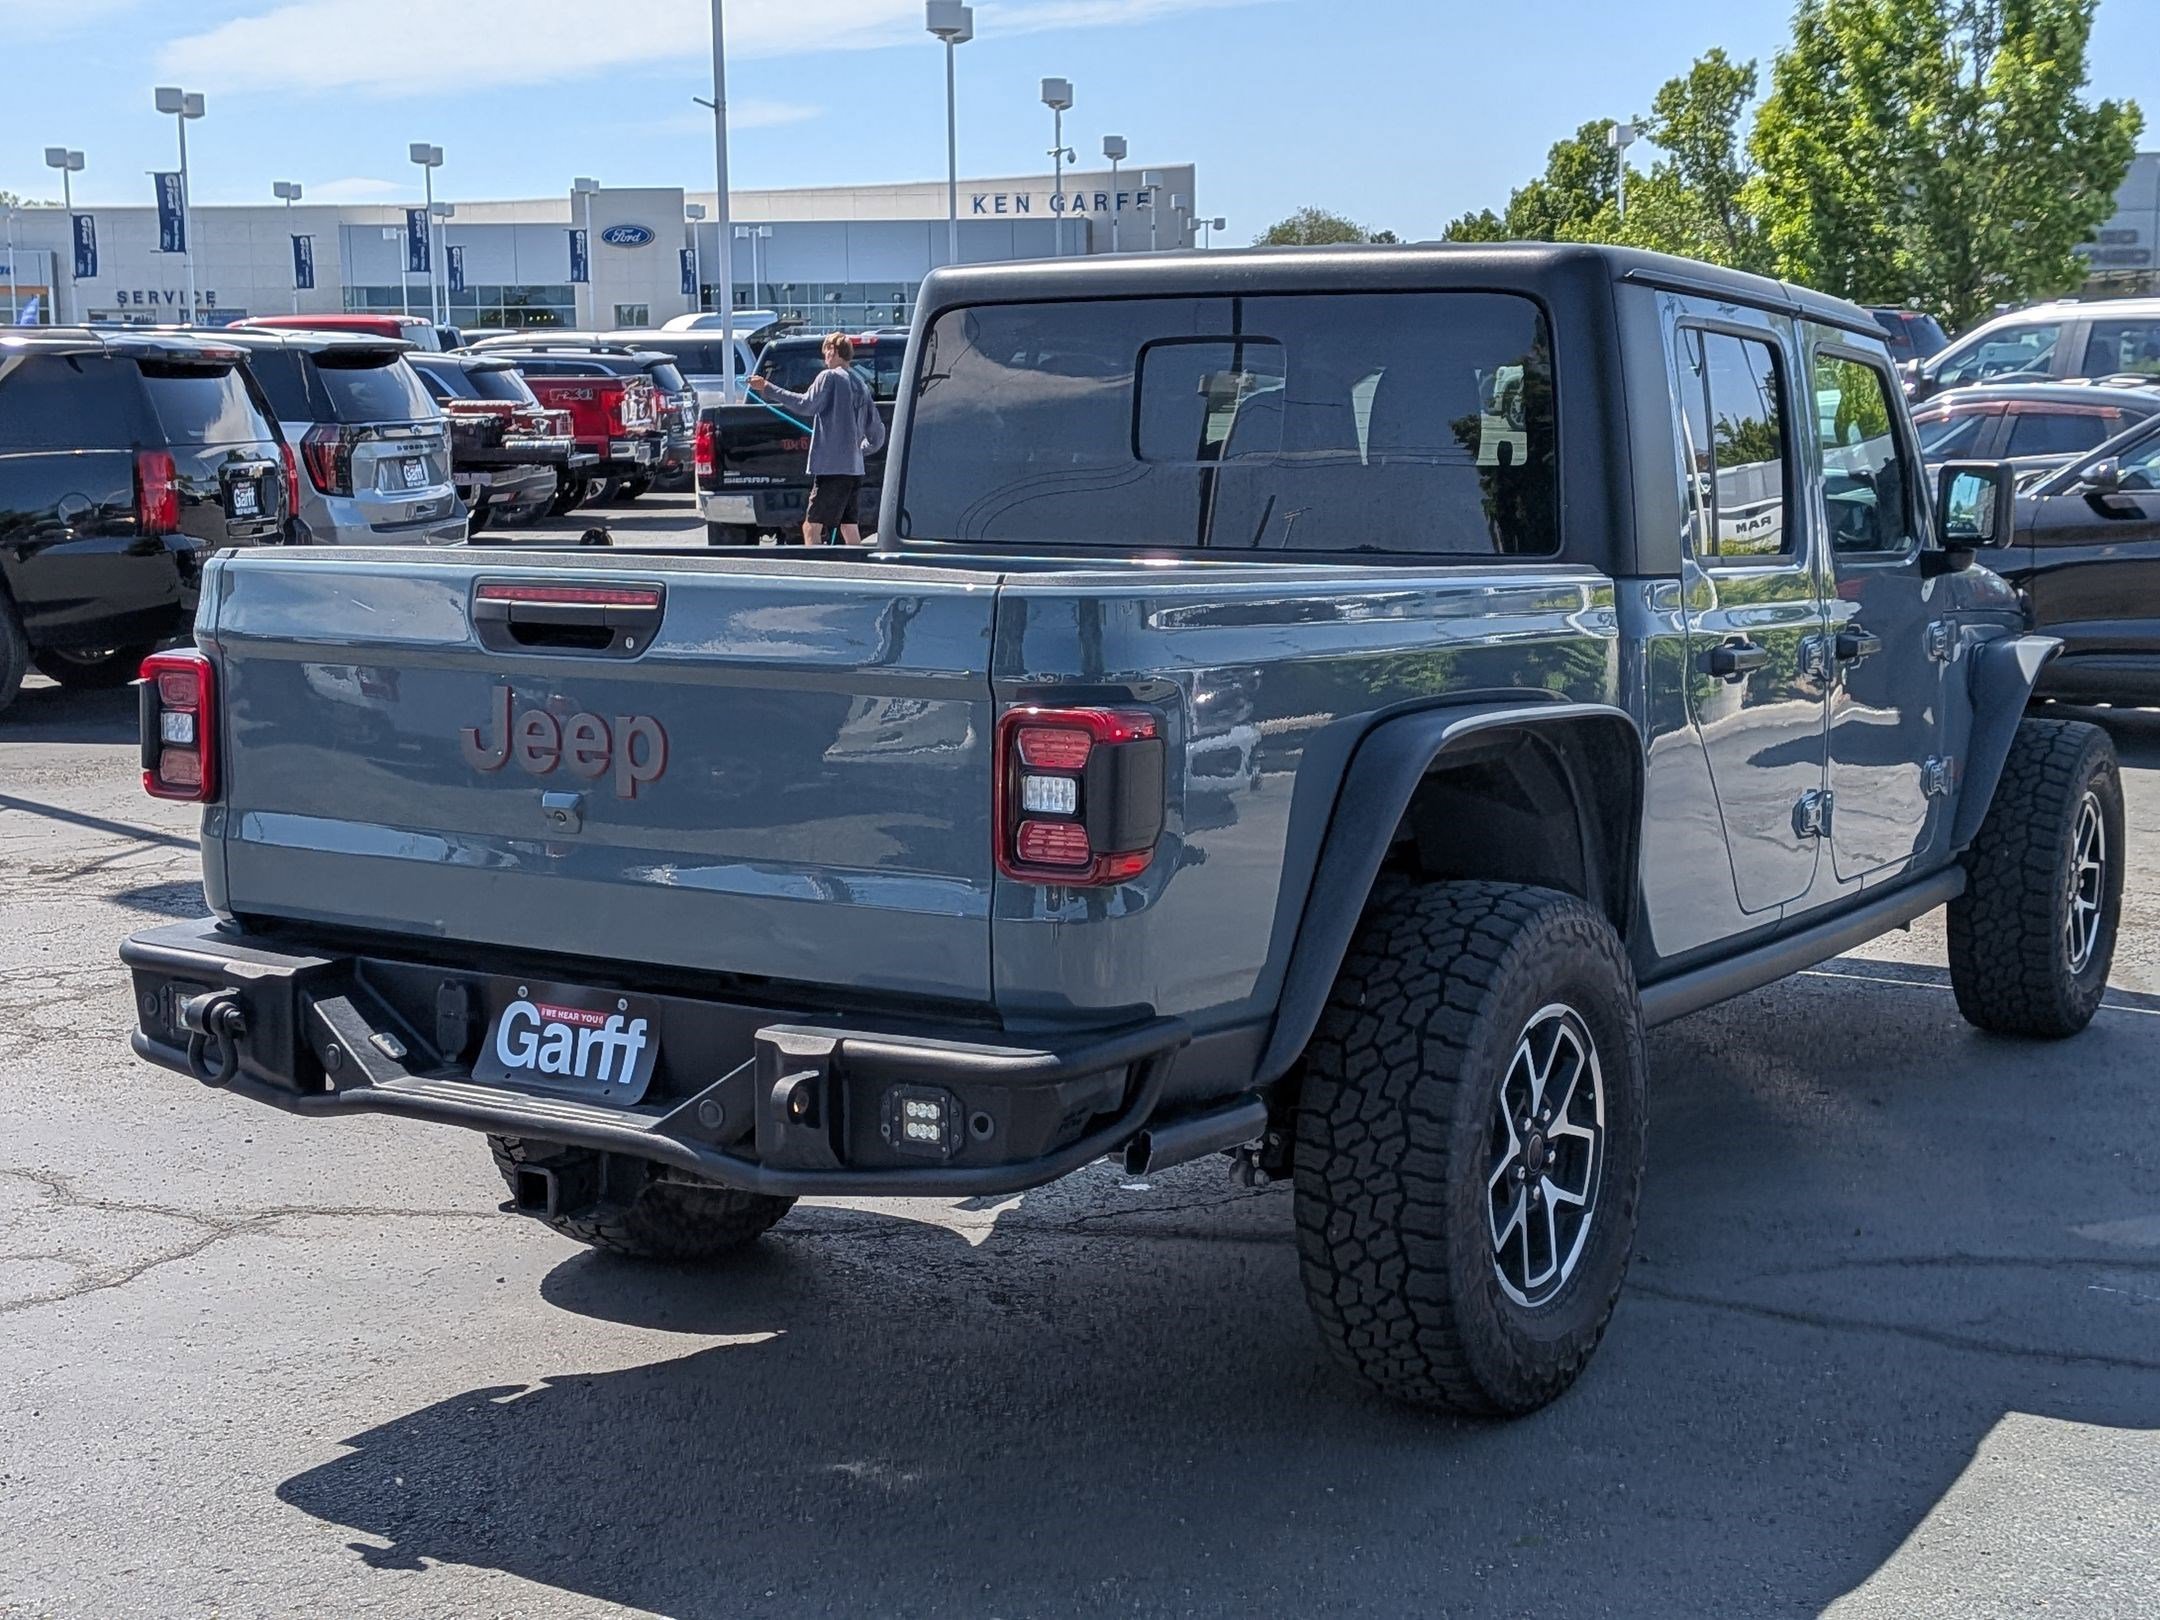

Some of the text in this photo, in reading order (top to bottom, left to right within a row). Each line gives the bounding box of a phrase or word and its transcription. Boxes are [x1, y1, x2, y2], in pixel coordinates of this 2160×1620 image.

[973, 192, 1150, 214] KEN GARFF
[612, 230, 641, 242] Ford
[234, 487, 255, 508] Garff
[460, 686, 669, 799] Jeep
[546, 1009, 599, 1023] WE HEAR YOU
[497, 1001, 647, 1083] Garff
